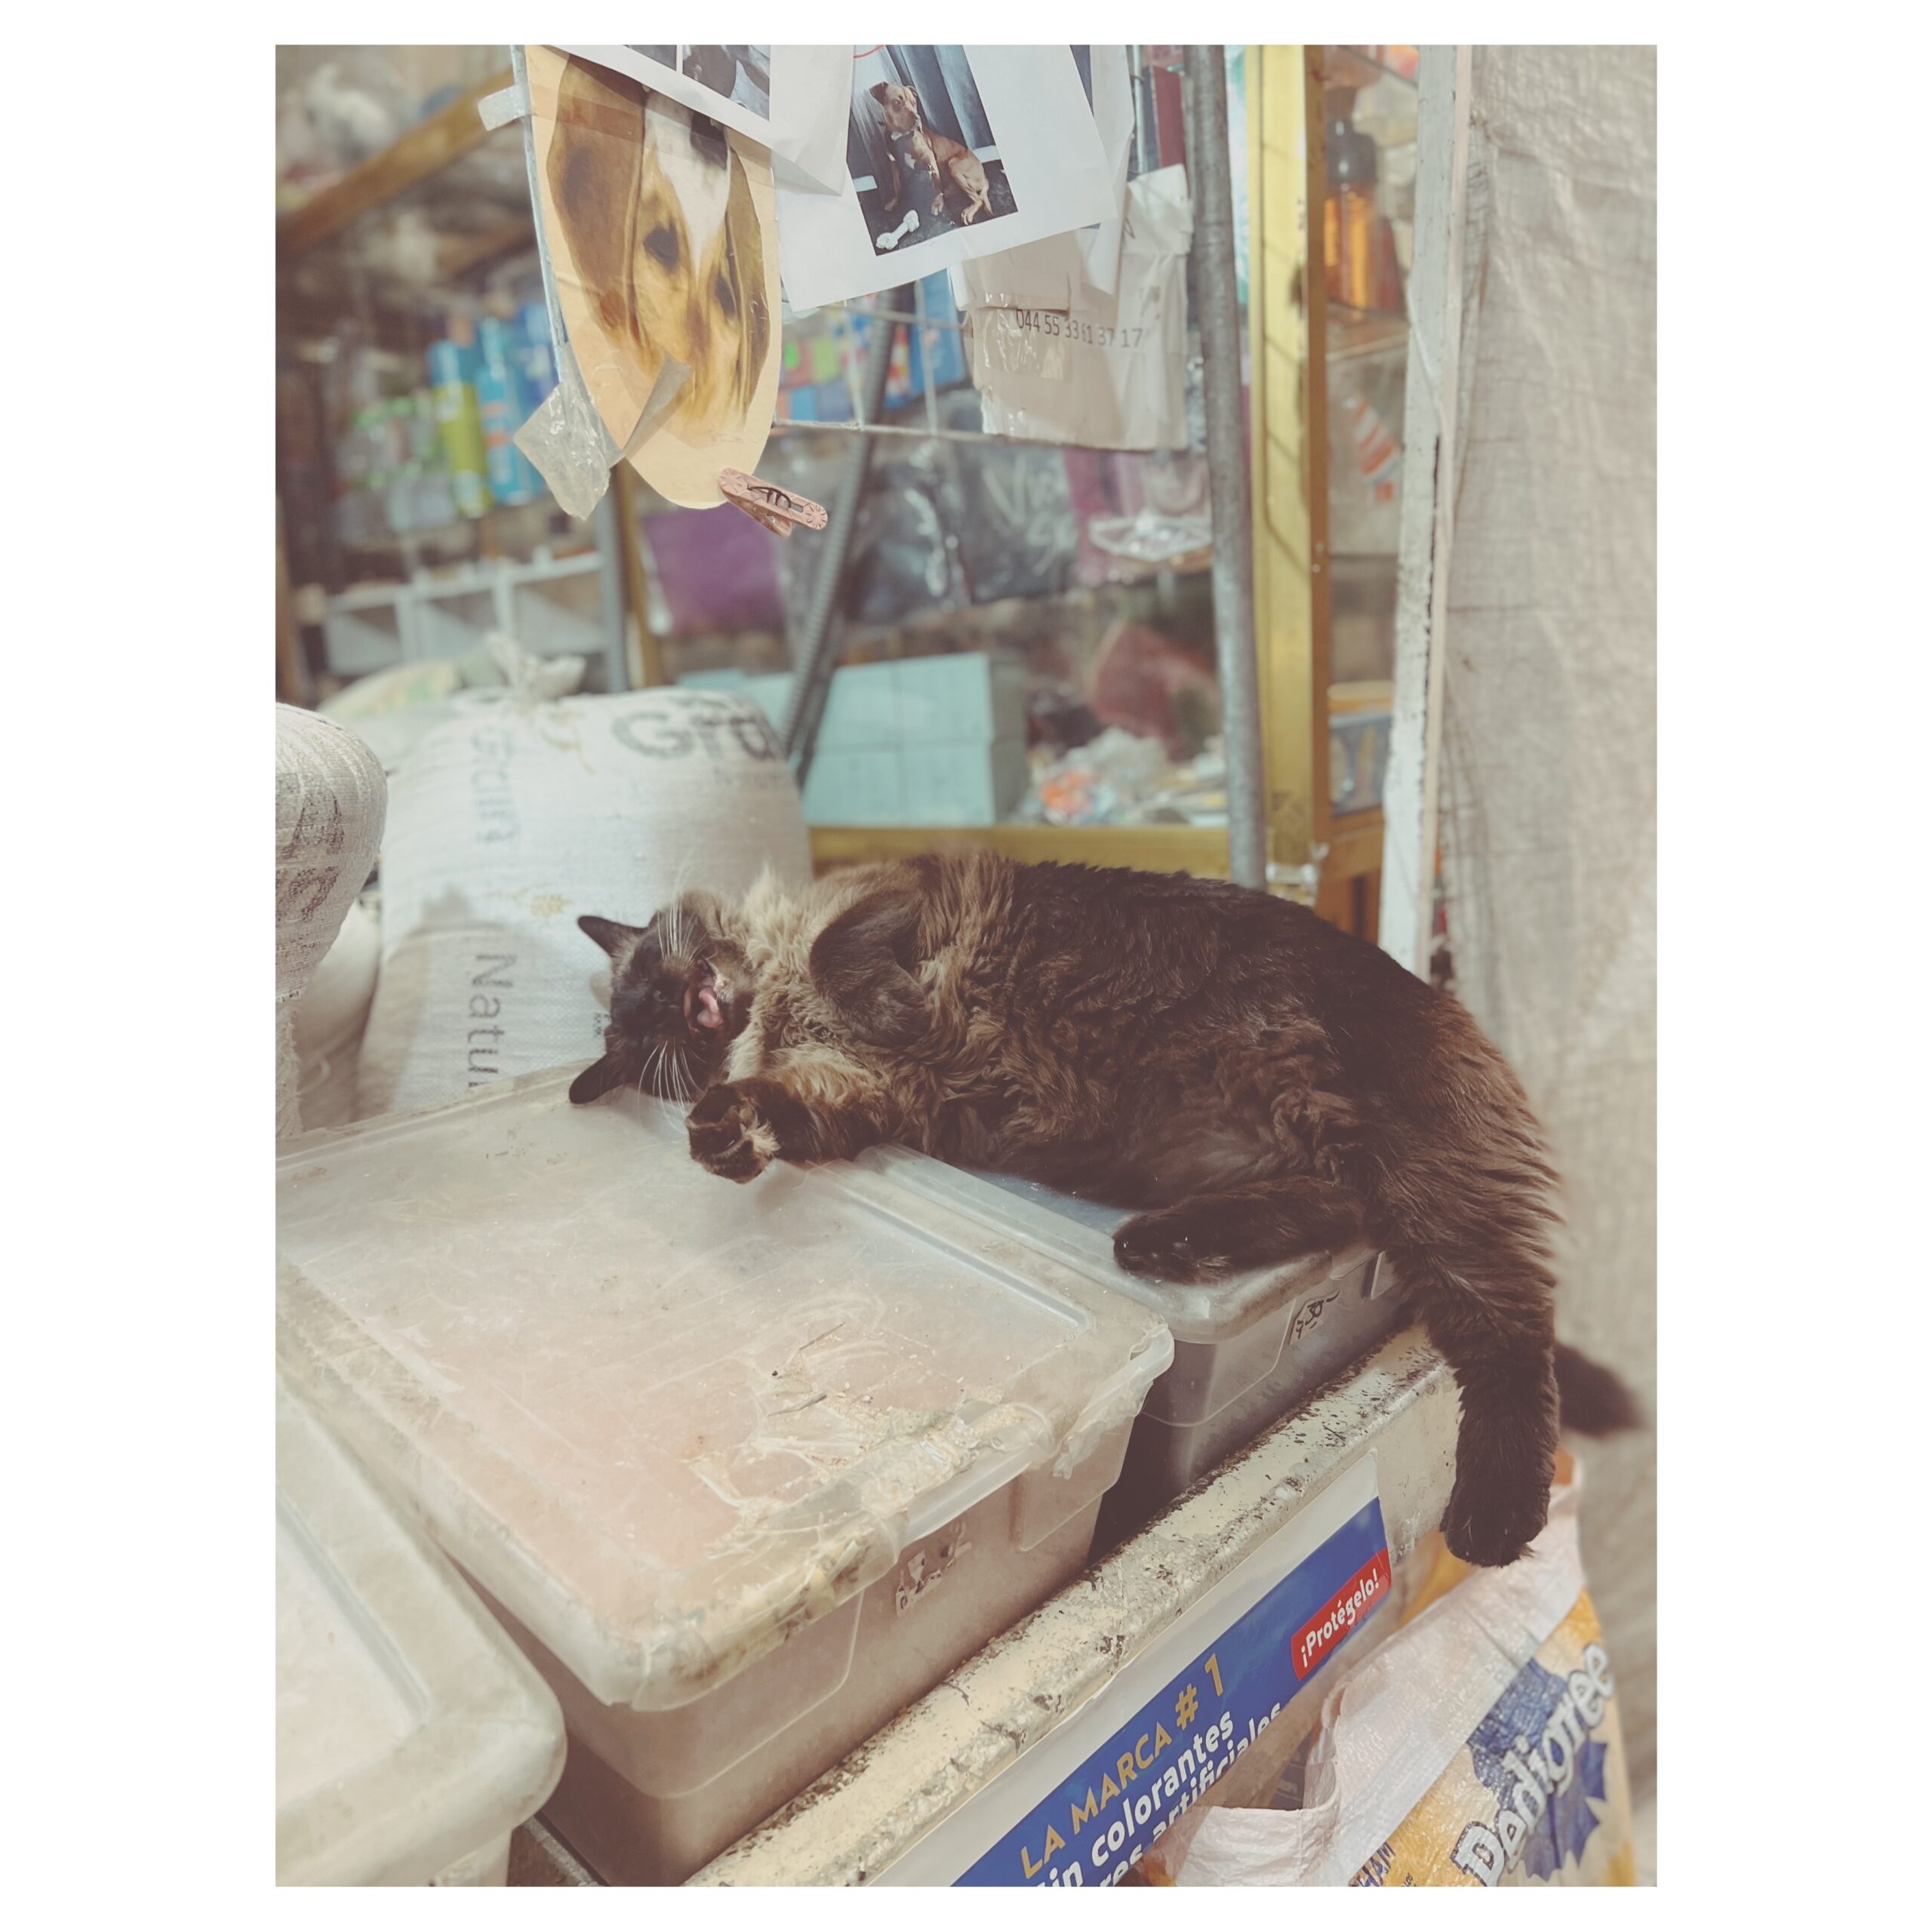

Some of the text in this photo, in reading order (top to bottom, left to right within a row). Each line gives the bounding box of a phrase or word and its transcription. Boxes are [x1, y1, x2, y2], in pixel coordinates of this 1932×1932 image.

[1016, 309, 1040, 332] 044
[1044, 314, 1060, 337] 55
[1064, 318, 1079, 340] 33
[1097, 326, 1115, 347] 37
[1121, 328, 1143, 349] 17
[1301, 1567, 1380, 1669] ¡Protégelo!
[1020, 1824, 1066, 1879] LA
[1070, 1721, 1173, 1835] MARCA
[1204, 1653, 1223, 1697] 1
[1036, 1711, 1234, 1887] in colorantes
